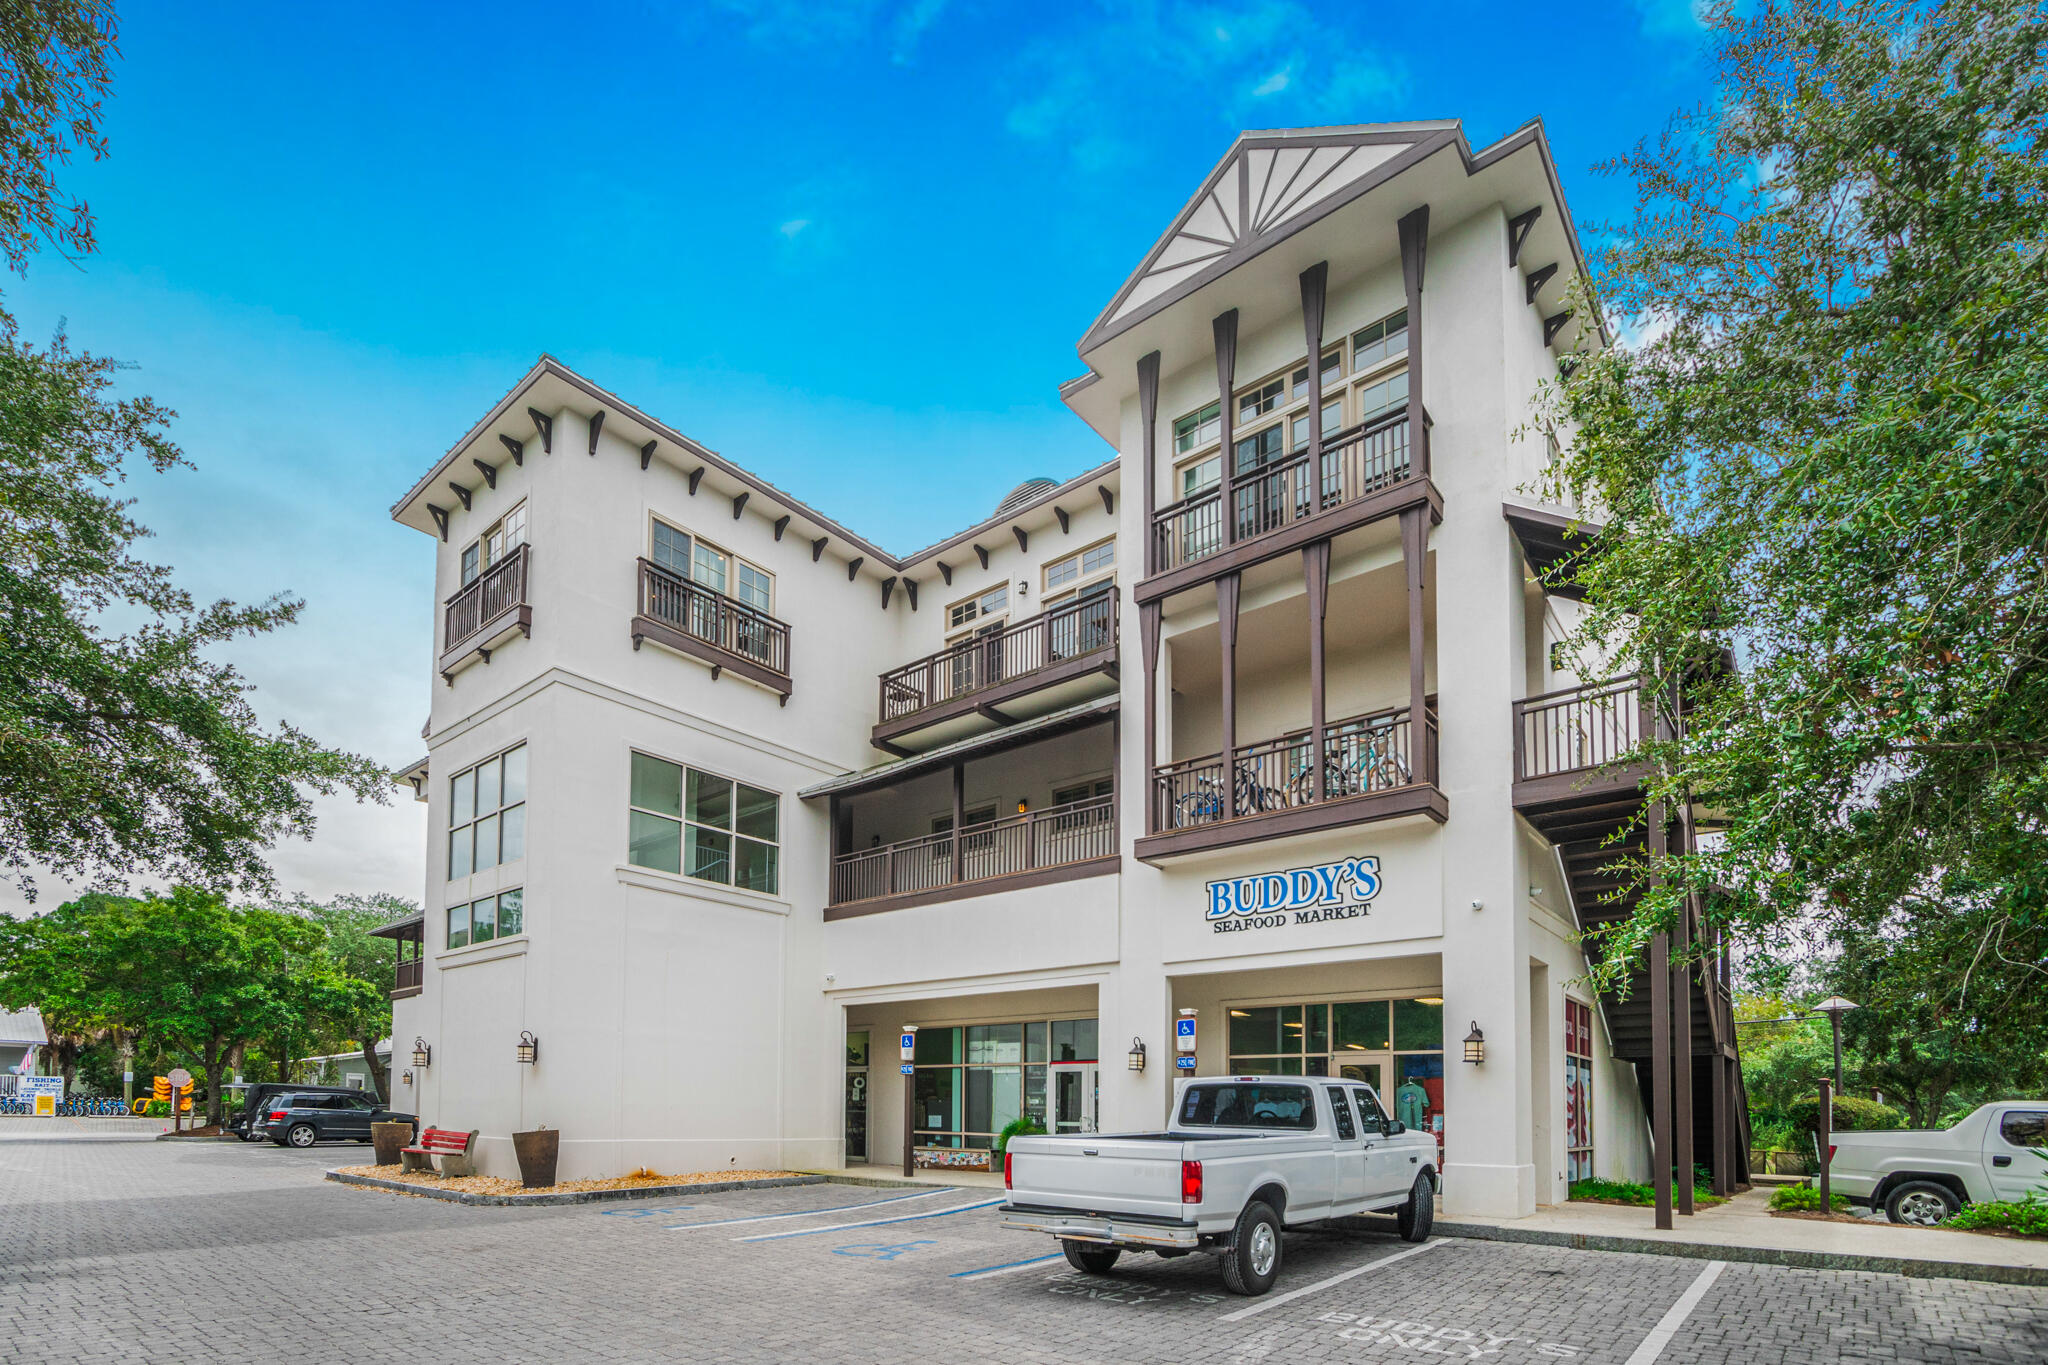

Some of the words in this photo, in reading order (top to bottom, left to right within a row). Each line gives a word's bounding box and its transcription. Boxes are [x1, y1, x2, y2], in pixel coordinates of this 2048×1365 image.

[1207, 857, 1381, 918] BUDDY'S
[1213, 914, 1287, 934] SEAFOOD
[1294, 903, 1372, 924] MARKET
[1316, 1311, 1581, 1357] BUDDY'S
[1337, 1327, 1502, 1359] ONLY
